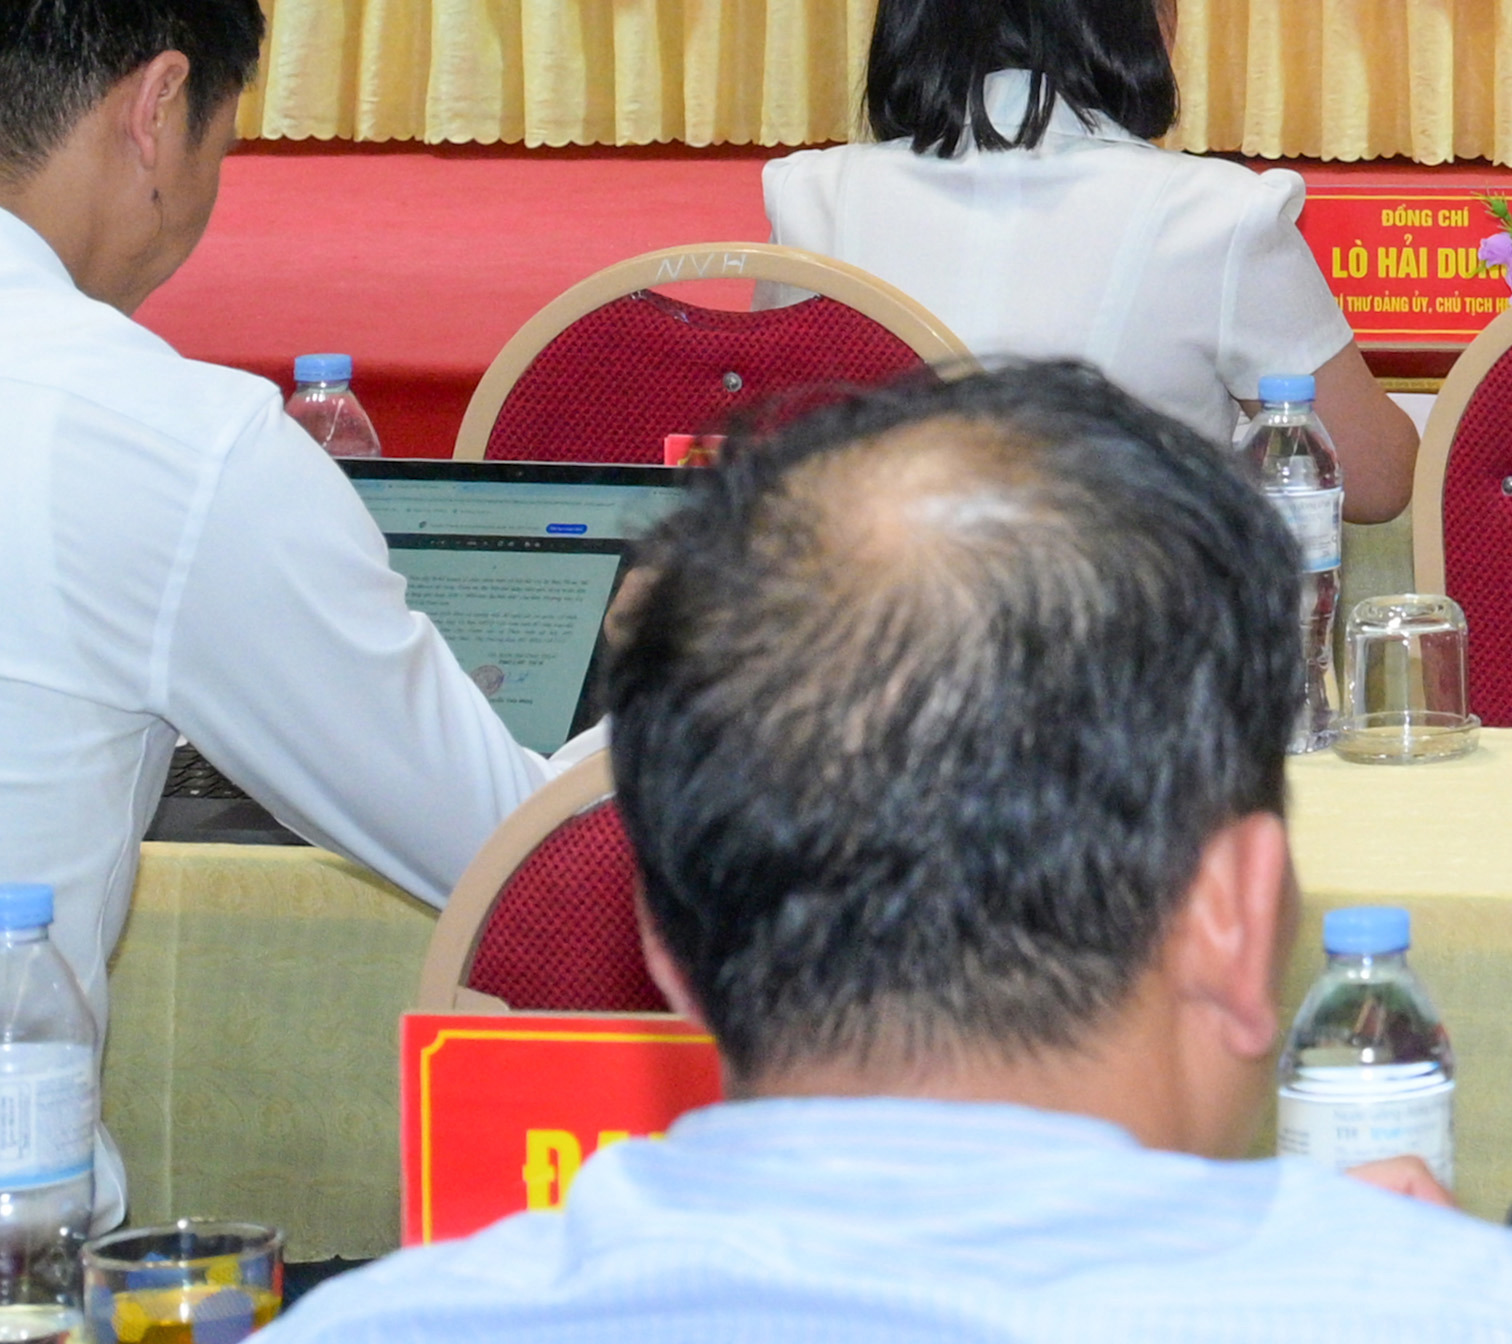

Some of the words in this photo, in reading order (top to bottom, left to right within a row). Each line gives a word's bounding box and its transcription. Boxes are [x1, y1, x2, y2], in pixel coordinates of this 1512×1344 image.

[1381, 203, 1433, 227] ĐỒNG
[1437, 205, 1470, 227] CHÍ
[1331, 239, 1368, 279] LÒ
[1377, 234, 1428, 279] HẢI
[1437, 247, 1508, 280] DU
[1346, 294, 1373, 312] THƯ
[1373, 289, 1410, 312] ĐẢNG
[1412, 289, 1433, 314] ỦY,
[1435, 290, 1461, 313] CHỦ
[1464, 296, 1493, 316] TỊCH
